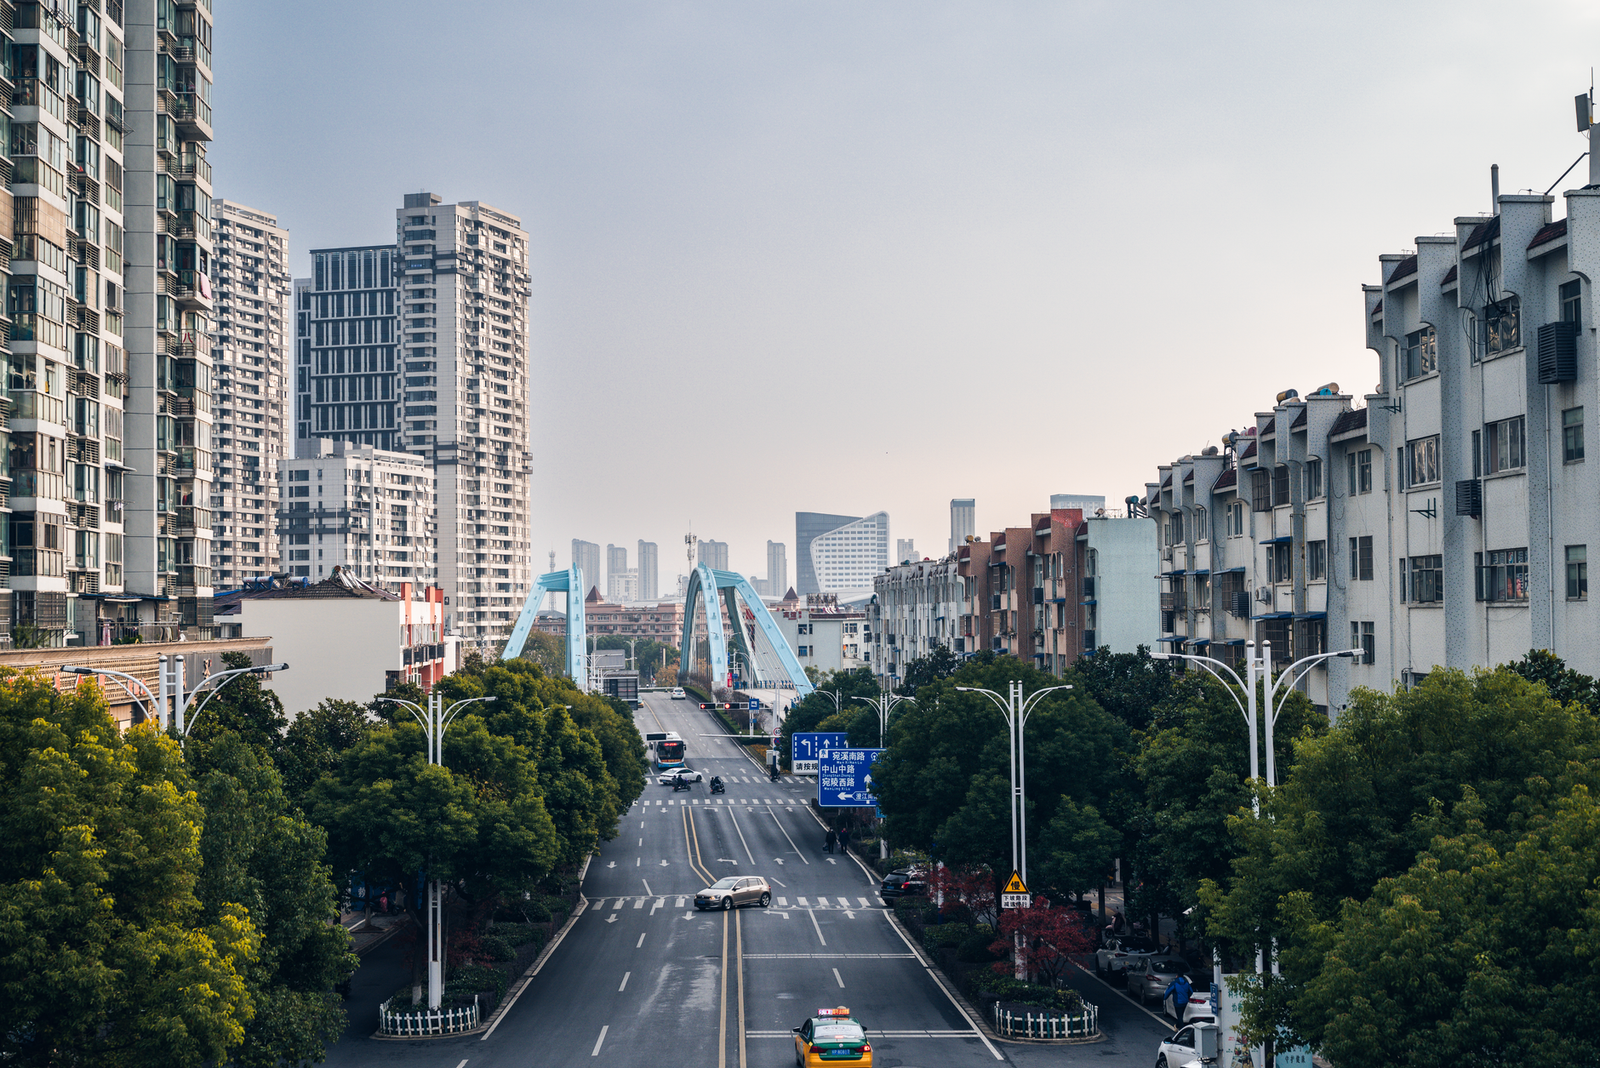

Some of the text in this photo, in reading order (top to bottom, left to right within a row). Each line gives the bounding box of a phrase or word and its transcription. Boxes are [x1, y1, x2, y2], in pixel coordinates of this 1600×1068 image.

[832, 752, 865, 761] 宛溪南路
[822, 764, 855, 774] 中山中路
[822, 778, 855, 787] 宛陵西路
[1011, 881, 1020, 890] 慢
